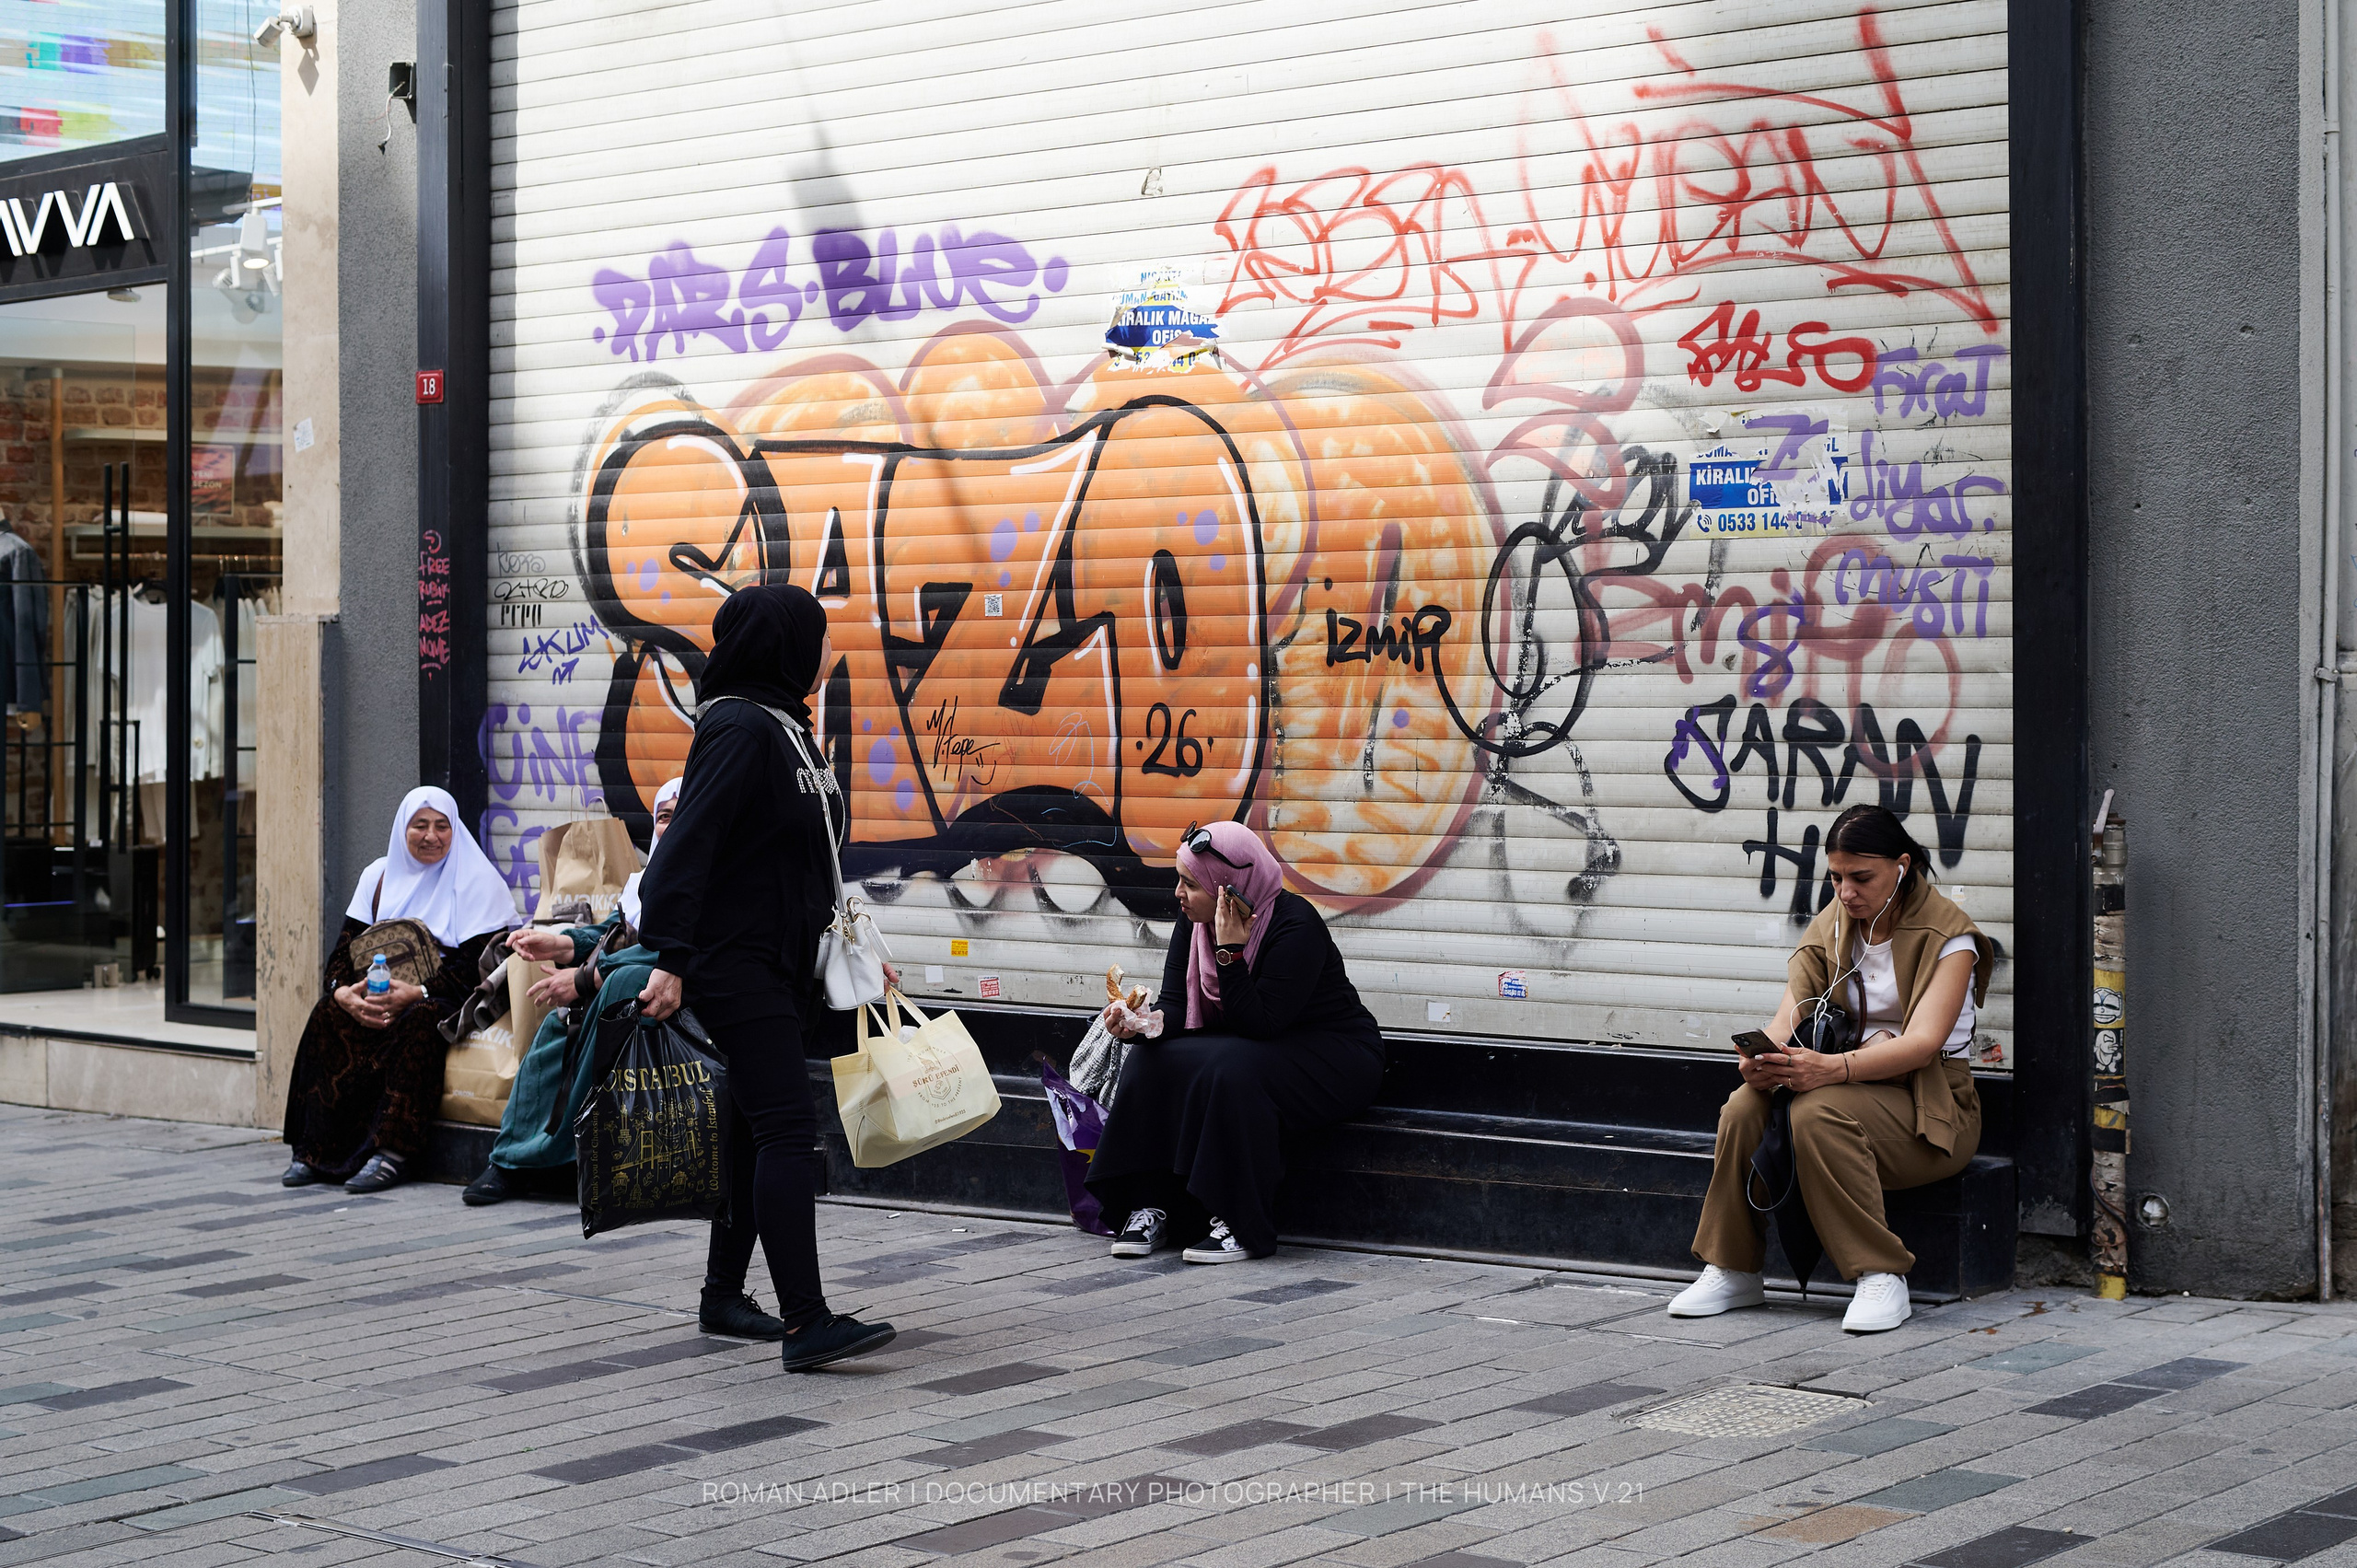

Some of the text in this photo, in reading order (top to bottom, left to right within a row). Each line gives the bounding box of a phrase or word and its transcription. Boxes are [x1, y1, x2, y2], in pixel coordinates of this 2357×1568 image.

[423, 377, 435, 395] 18
[1718, 512, 1756, 532] 0533
[710, 1132, 718, 1142] to
[708, 1144, 719, 1191] Welcome
